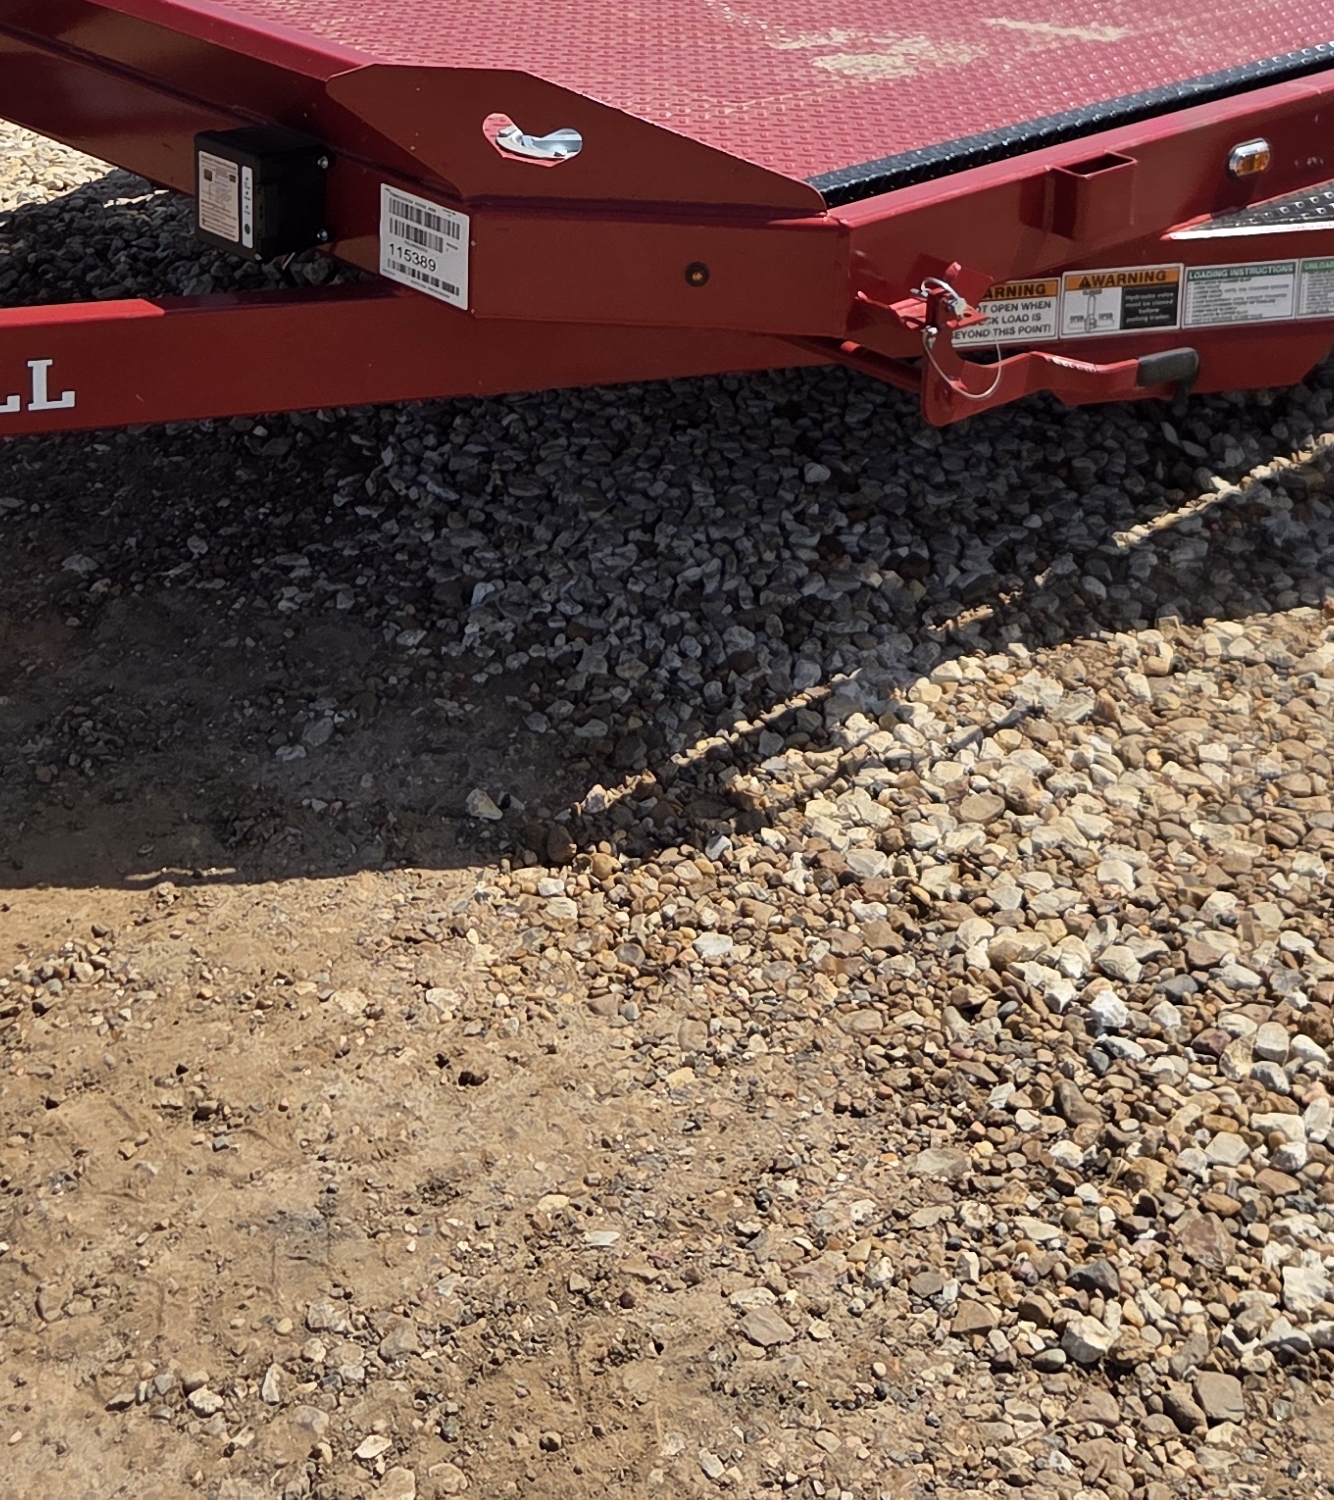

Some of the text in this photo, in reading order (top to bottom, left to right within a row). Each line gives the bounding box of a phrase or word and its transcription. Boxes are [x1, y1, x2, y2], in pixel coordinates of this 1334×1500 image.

[388, 243, 437, 272] 115389
[1091, 270, 1167, 288] WARNING
[1188, 264, 1294, 280] LOADING INSTRUCTIONS
[983, 283, 1046, 299] ARNING
[990, 303, 1019, 313] OPEN
[1021, 301, 1052, 311] WHEN
[1001, 314, 1030, 325] LOAD
[1032, 313, 1042, 322] IS
[953, 329, 990, 340] EYOND
[993, 327, 1016, 337] THIS
